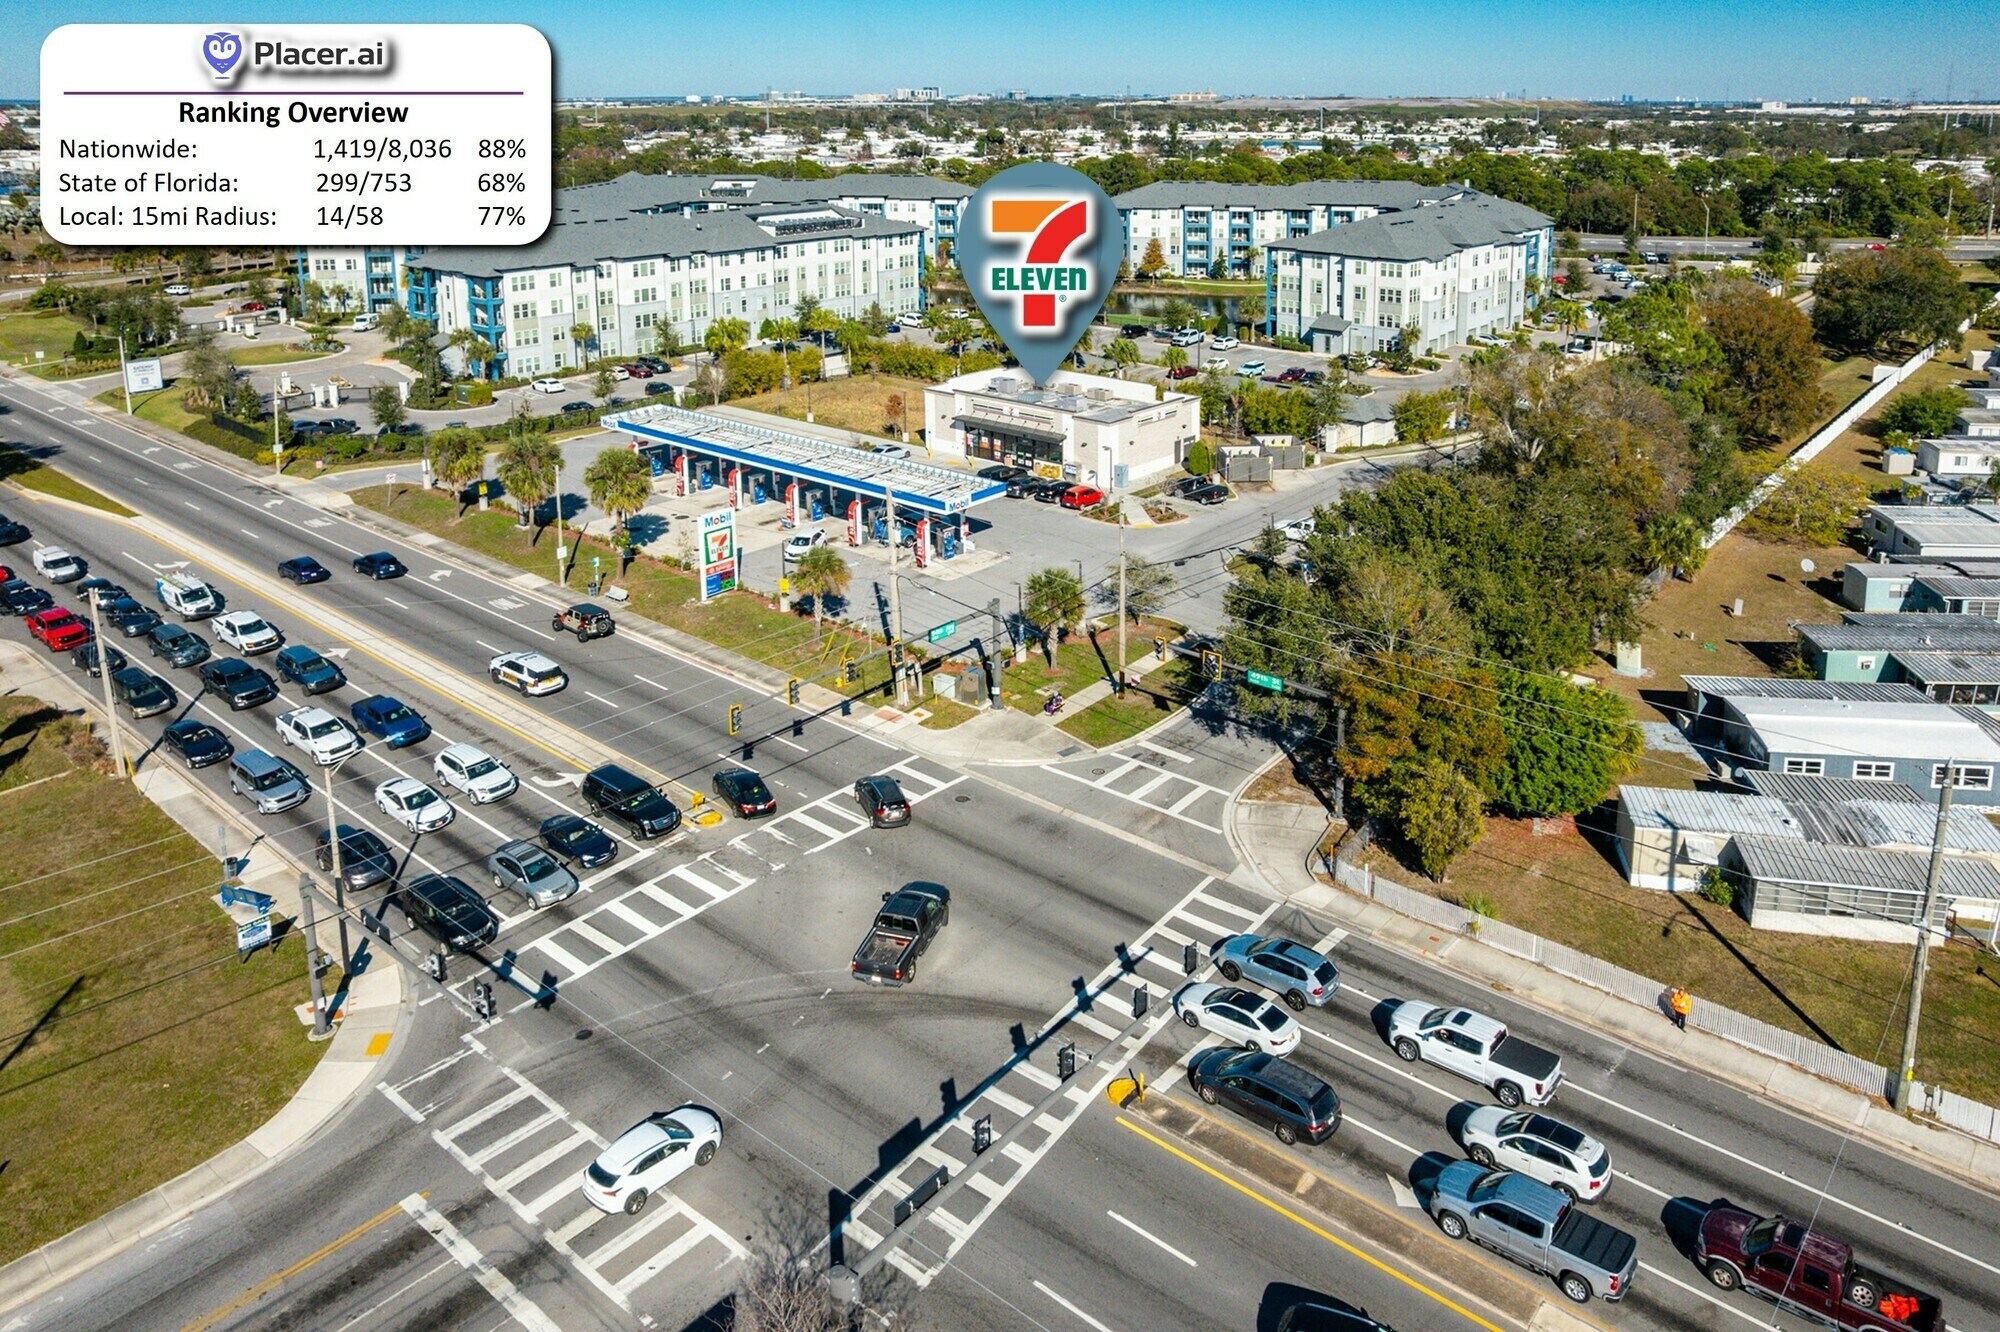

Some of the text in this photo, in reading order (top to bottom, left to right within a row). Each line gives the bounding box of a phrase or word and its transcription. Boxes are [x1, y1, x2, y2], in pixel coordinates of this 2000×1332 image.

[949, 498, 969, 511] Mobil
[704, 511, 732, 528] Mobil
[1250, 672, 1268, 682] 49th
